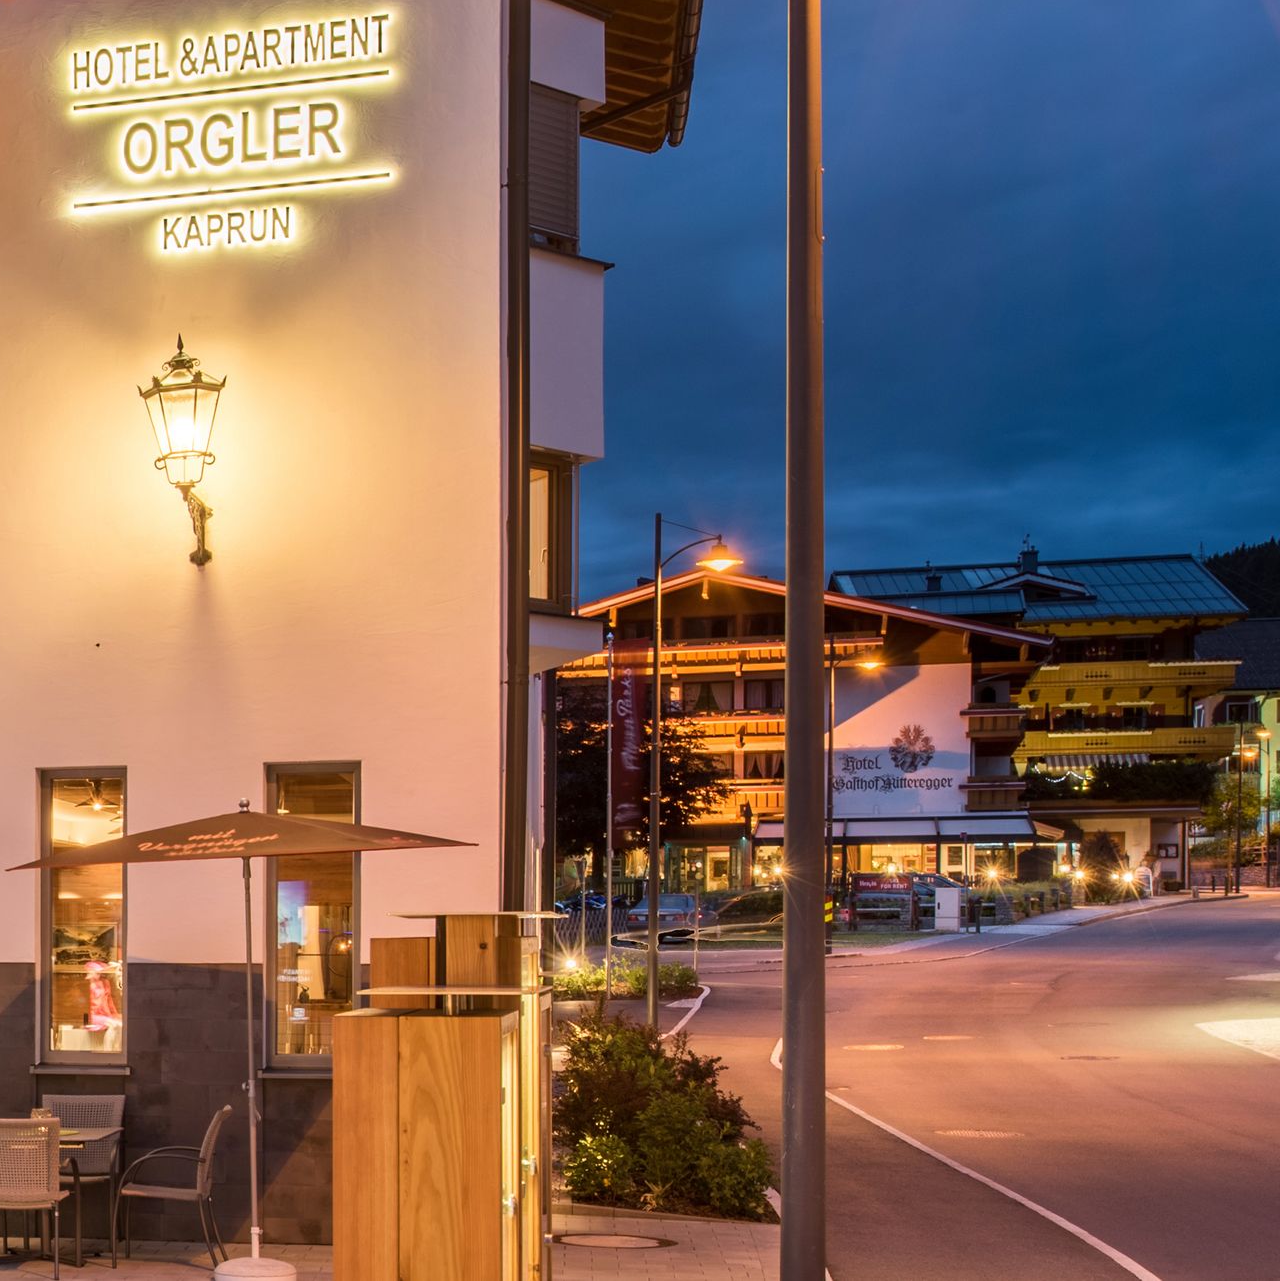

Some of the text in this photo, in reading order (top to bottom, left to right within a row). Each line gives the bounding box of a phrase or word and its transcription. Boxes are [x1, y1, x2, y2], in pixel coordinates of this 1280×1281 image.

[72, 42, 169, 89] HOTEL
[123, 102, 341, 175] ORGLER
[163, 206, 290, 249] KAPRUN
[840, 754, 882, 774] Hotel
